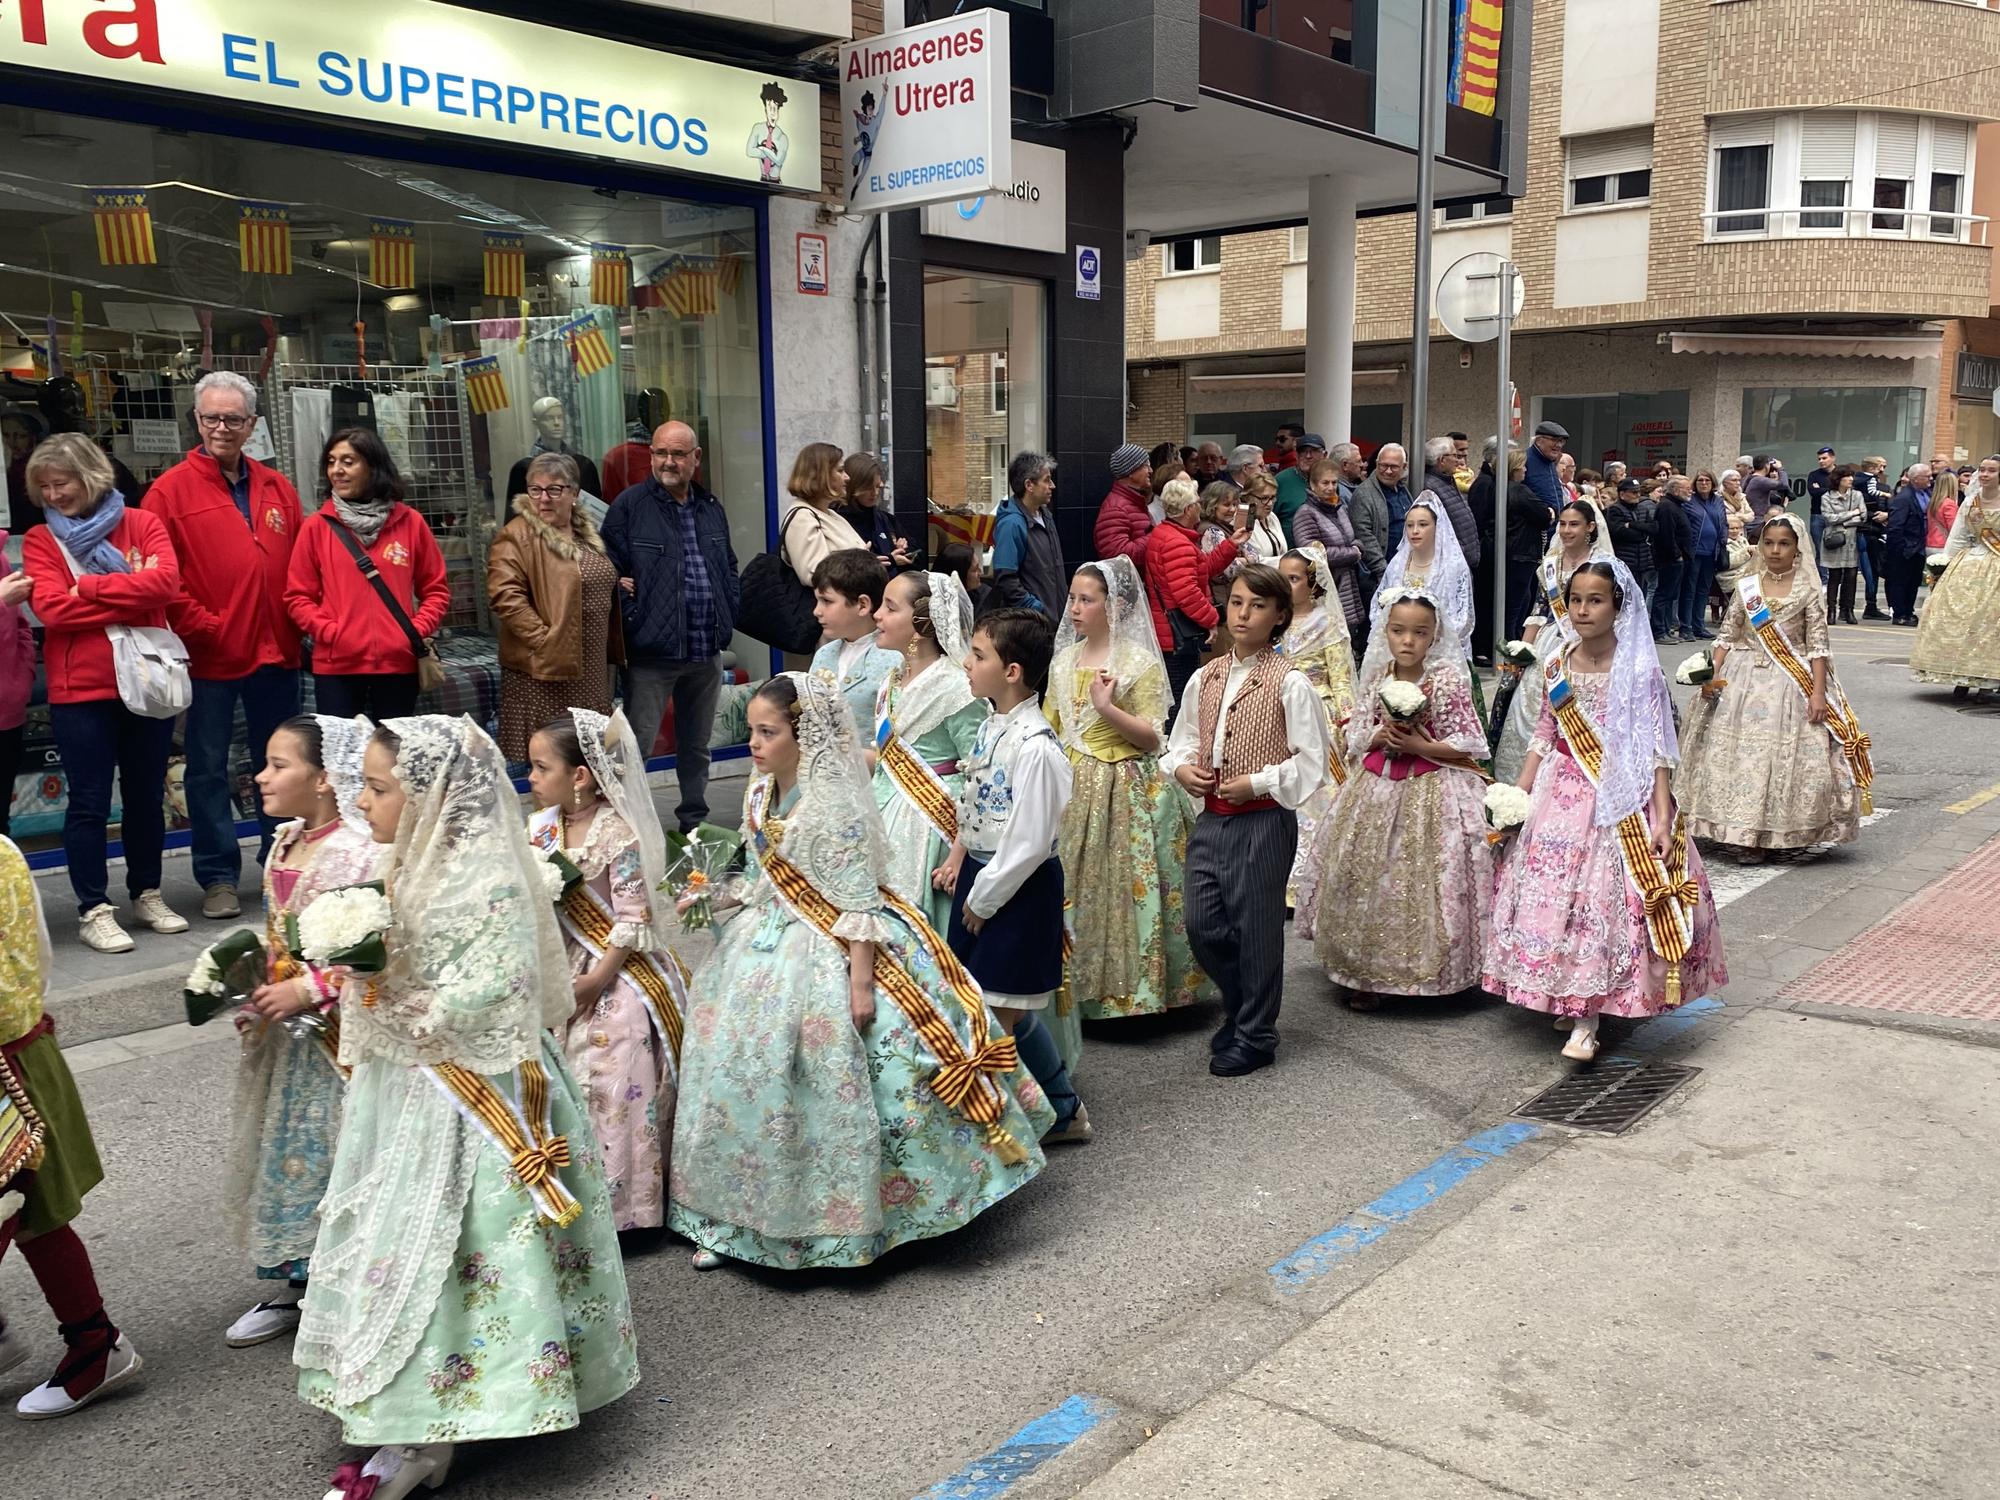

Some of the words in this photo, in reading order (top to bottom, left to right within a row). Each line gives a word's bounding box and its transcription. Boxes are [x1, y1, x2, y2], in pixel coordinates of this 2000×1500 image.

[846, 27, 984, 82] Almacenes
[223, 33, 300, 88] EL
[317, 51, 709, 156] SUPERPRECIOS
[894, 76, 975, 117] Utrera
[870, 174, 885, 193] EL
[888, 156, 985, 190] SUPERPRECIOS
[1082, 259, 1096, 271] ADT
[1962, 360, 1986, 388] MODA
